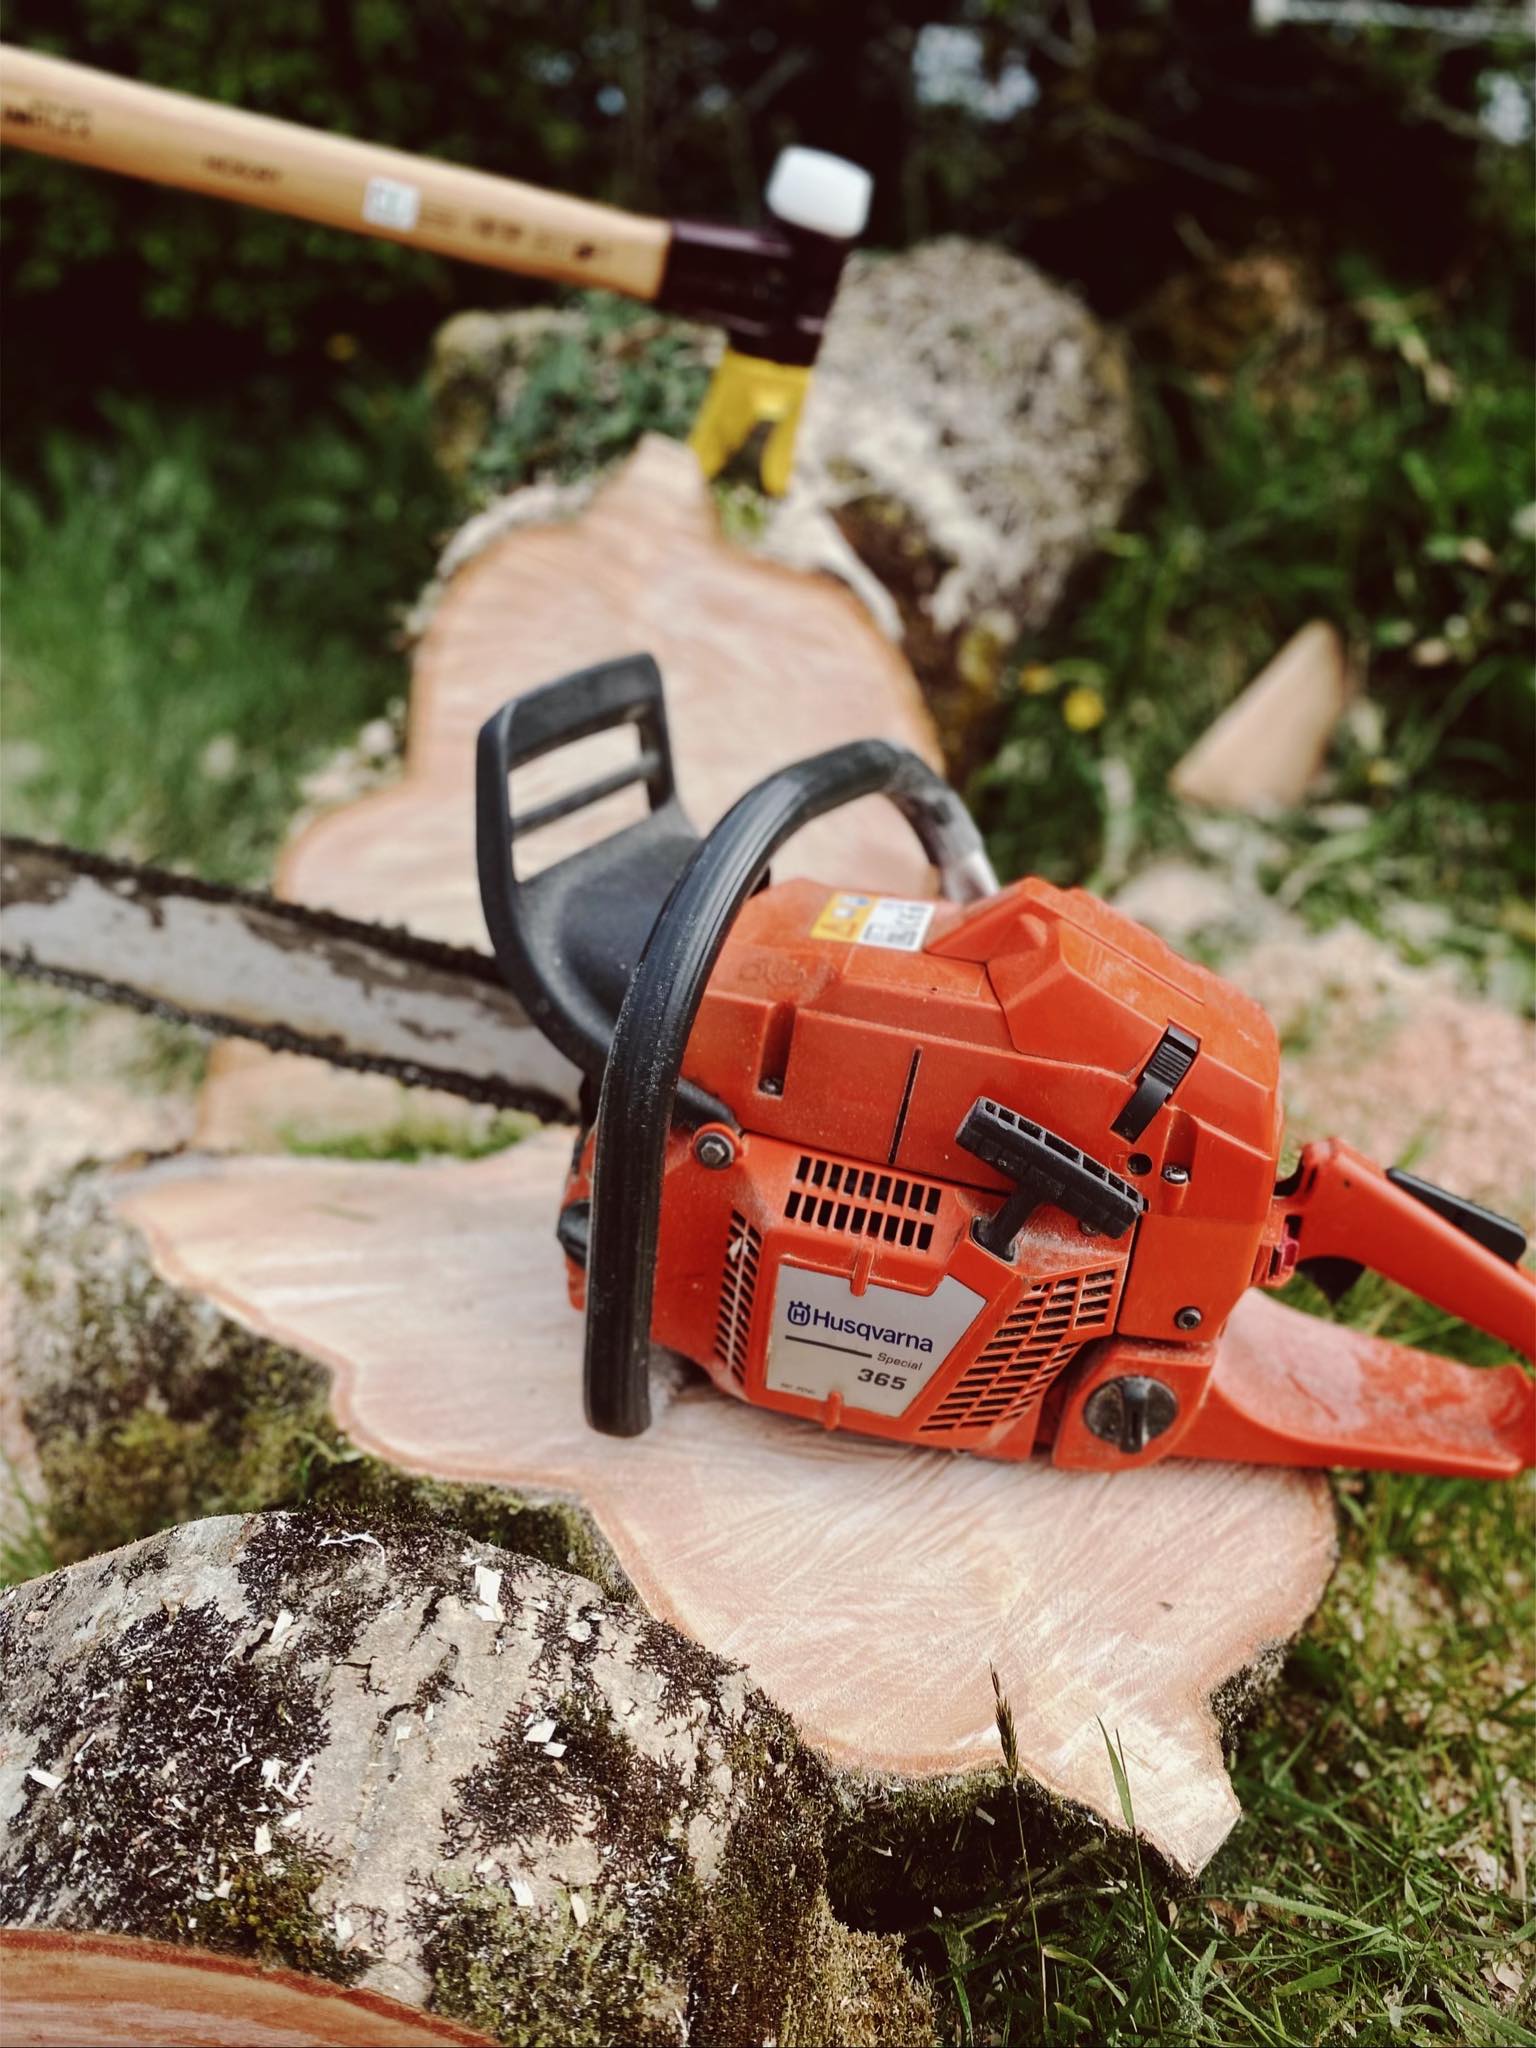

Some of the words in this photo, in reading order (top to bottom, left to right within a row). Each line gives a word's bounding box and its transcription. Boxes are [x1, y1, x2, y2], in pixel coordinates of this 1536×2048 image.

[813, 1309, 933, 1353] Husqvarna
[877, 1352, 922, 1371] Special
[857, 1368, 907, 1391] 365
